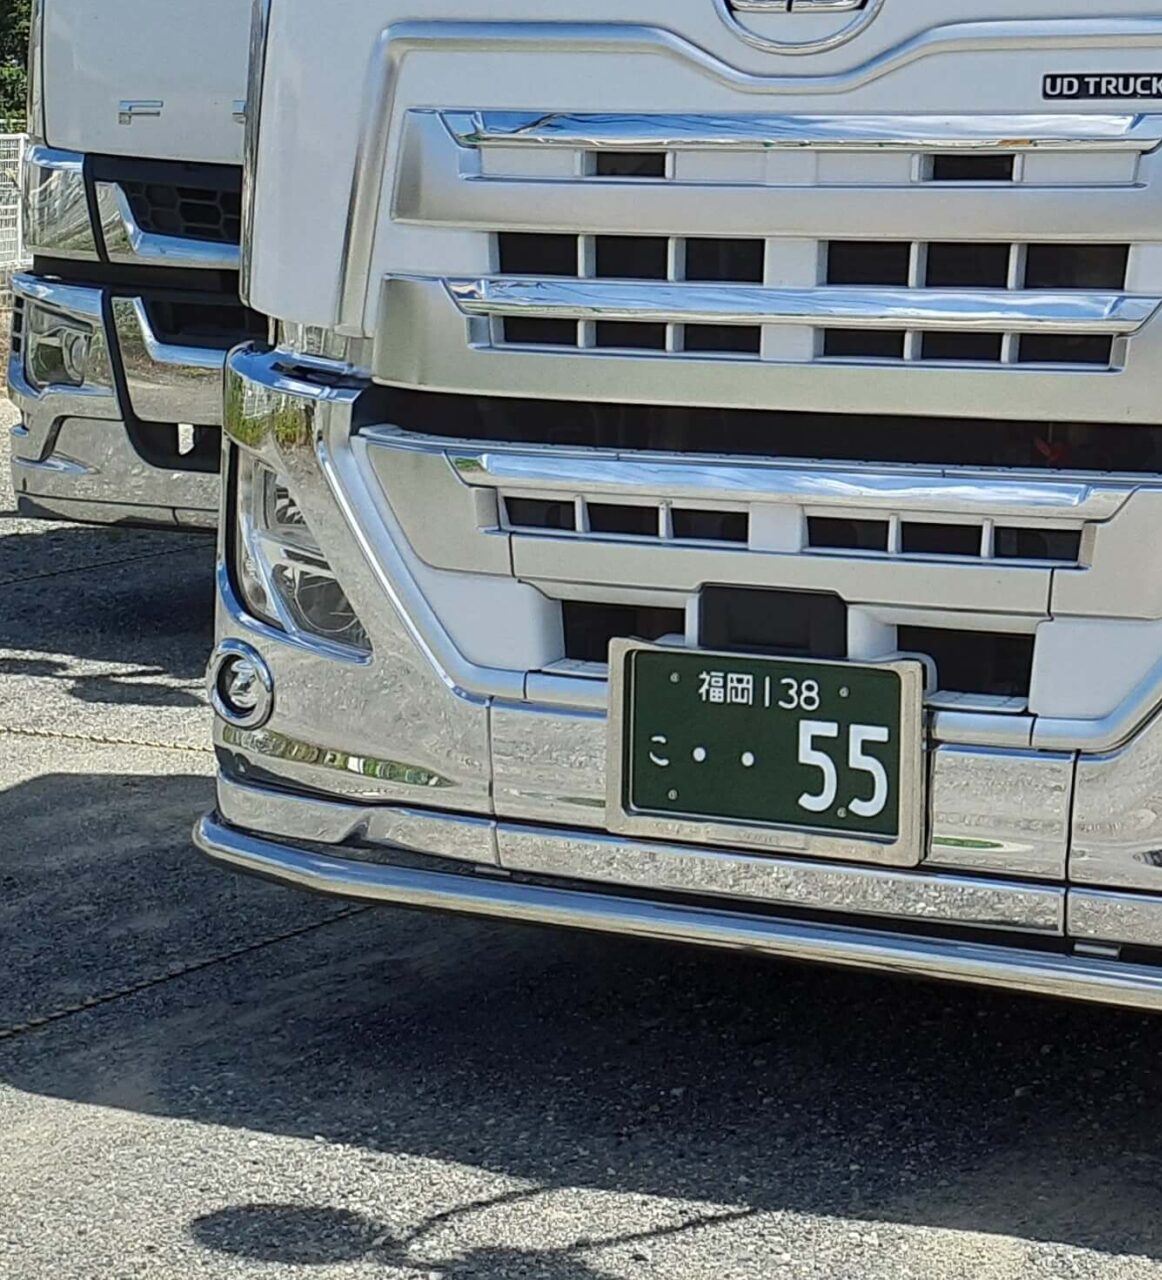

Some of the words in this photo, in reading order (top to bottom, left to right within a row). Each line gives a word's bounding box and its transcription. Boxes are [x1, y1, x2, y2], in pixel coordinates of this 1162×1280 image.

[1045, 76, 1079, 96] UD
[698, 671, 753, 705] 福岡
[763, 676, 821, 711] 138
[649, 735, 670, 766] こ
[798, 719, 889, 817] 55
